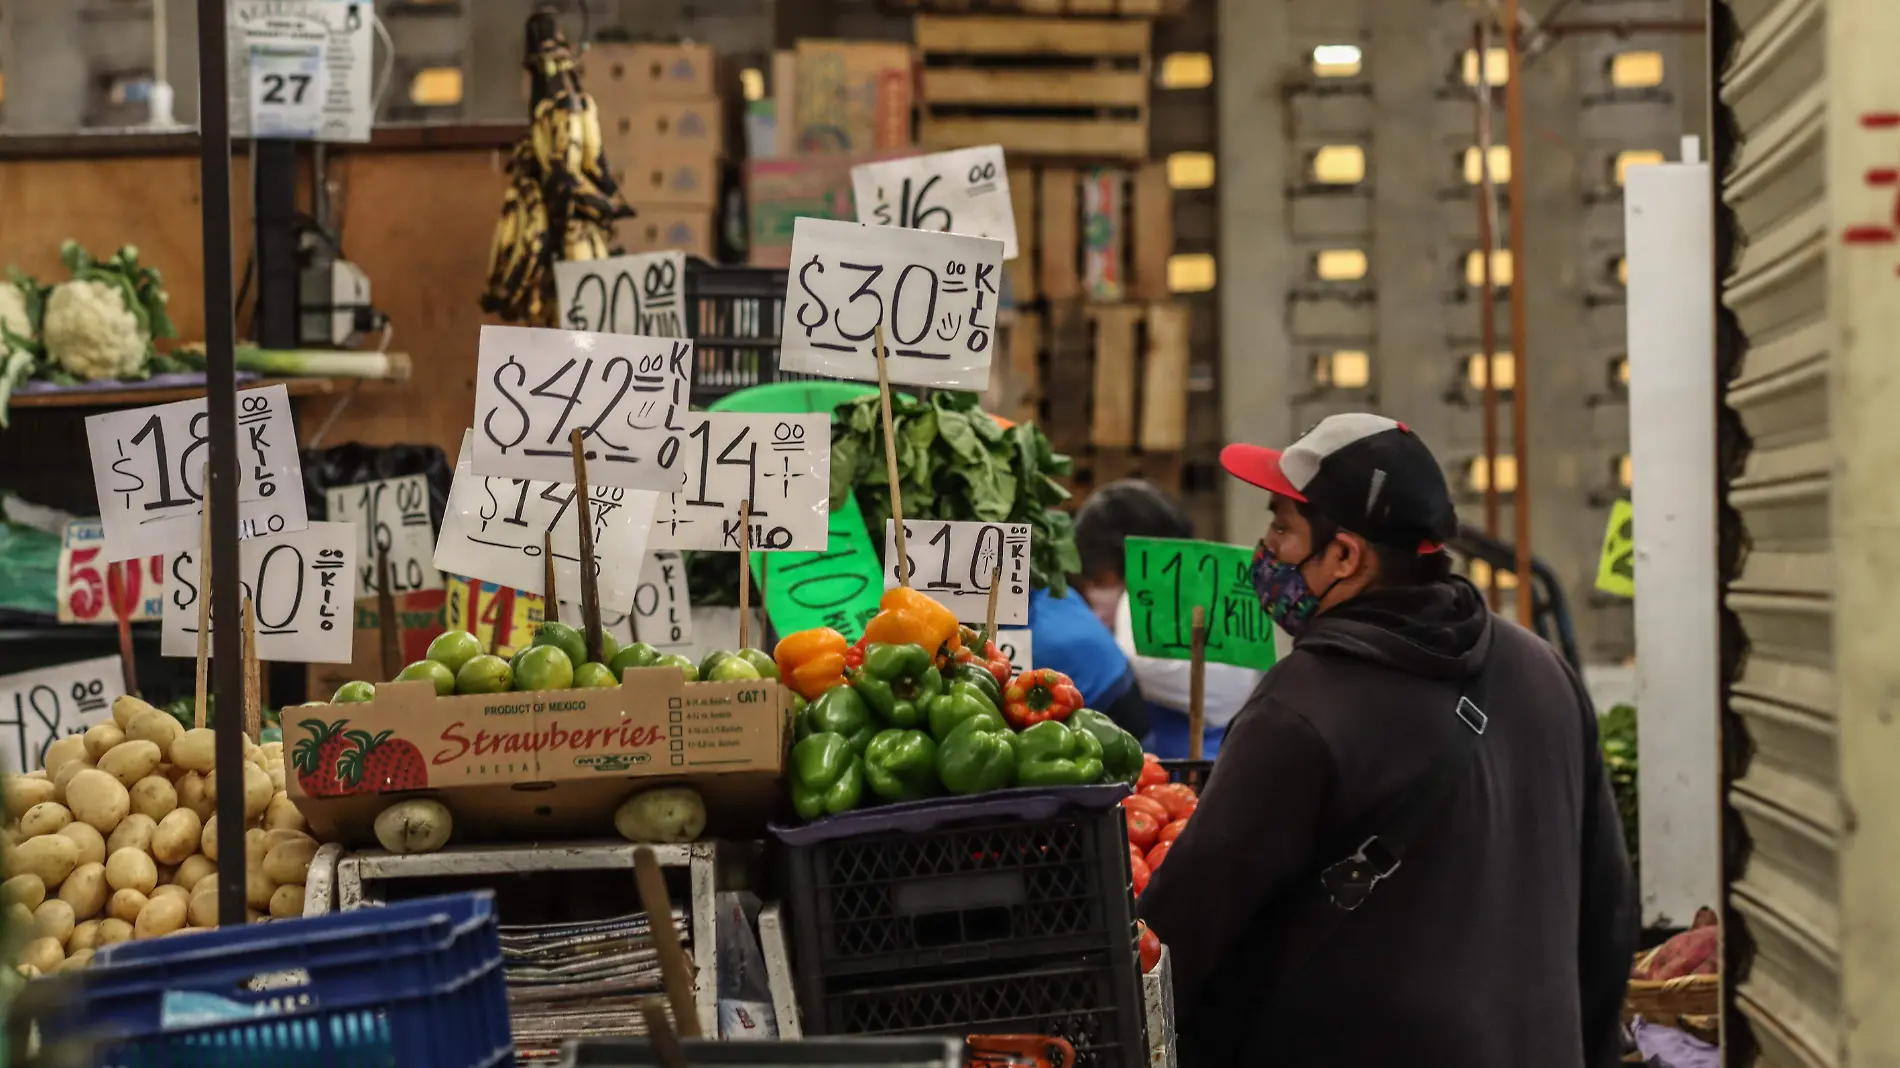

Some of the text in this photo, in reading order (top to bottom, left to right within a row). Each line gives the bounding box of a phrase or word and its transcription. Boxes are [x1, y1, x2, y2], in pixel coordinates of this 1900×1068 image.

[262, 74, 313, 104] 27
[796, 255, 939, 345] $30
[966, 263, 996, 352] KILO
[483, 354, 635, 455] $42
[656, 341, 690, 469] KILO
[249, 424, 277, 497] KILO
[722, 520, 793, 550] KILO
[319, 571, 339, 631] KILO
[359, 557, 424, 593] KLO
[484, 700, 586, 716] PRODUCT OF MEXICO
[737, 690, 759, 703] CAT
[431, 717, 667, 766] Strawberries
